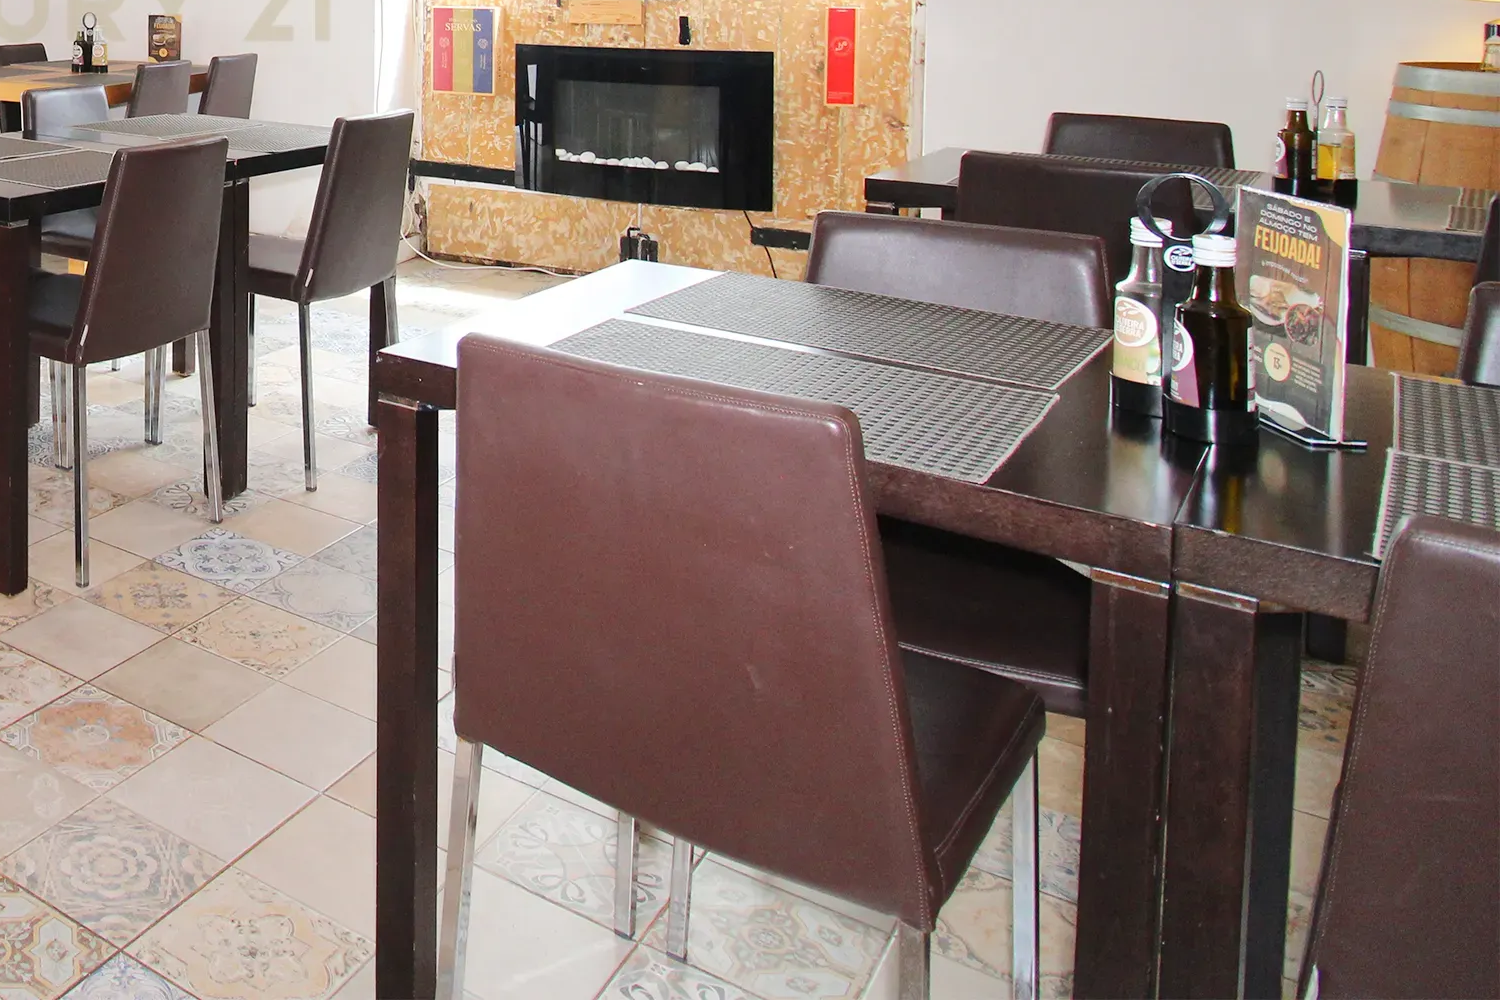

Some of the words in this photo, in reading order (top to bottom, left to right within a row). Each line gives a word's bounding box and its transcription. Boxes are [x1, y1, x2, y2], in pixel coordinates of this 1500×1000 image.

[1260, 209, 1302, 228] DOMINGO
[1303, 224, 1317, 233] NO
[1266, 203, 1302, 220] SÁBADO
[1304, 215, 1311, 223] E
[1259, 217, 1296, 234] ALMOÇO
[1298, 229, 1319, 242] TEM
[1254, 224, 1322, 270] FEIJOADA!
